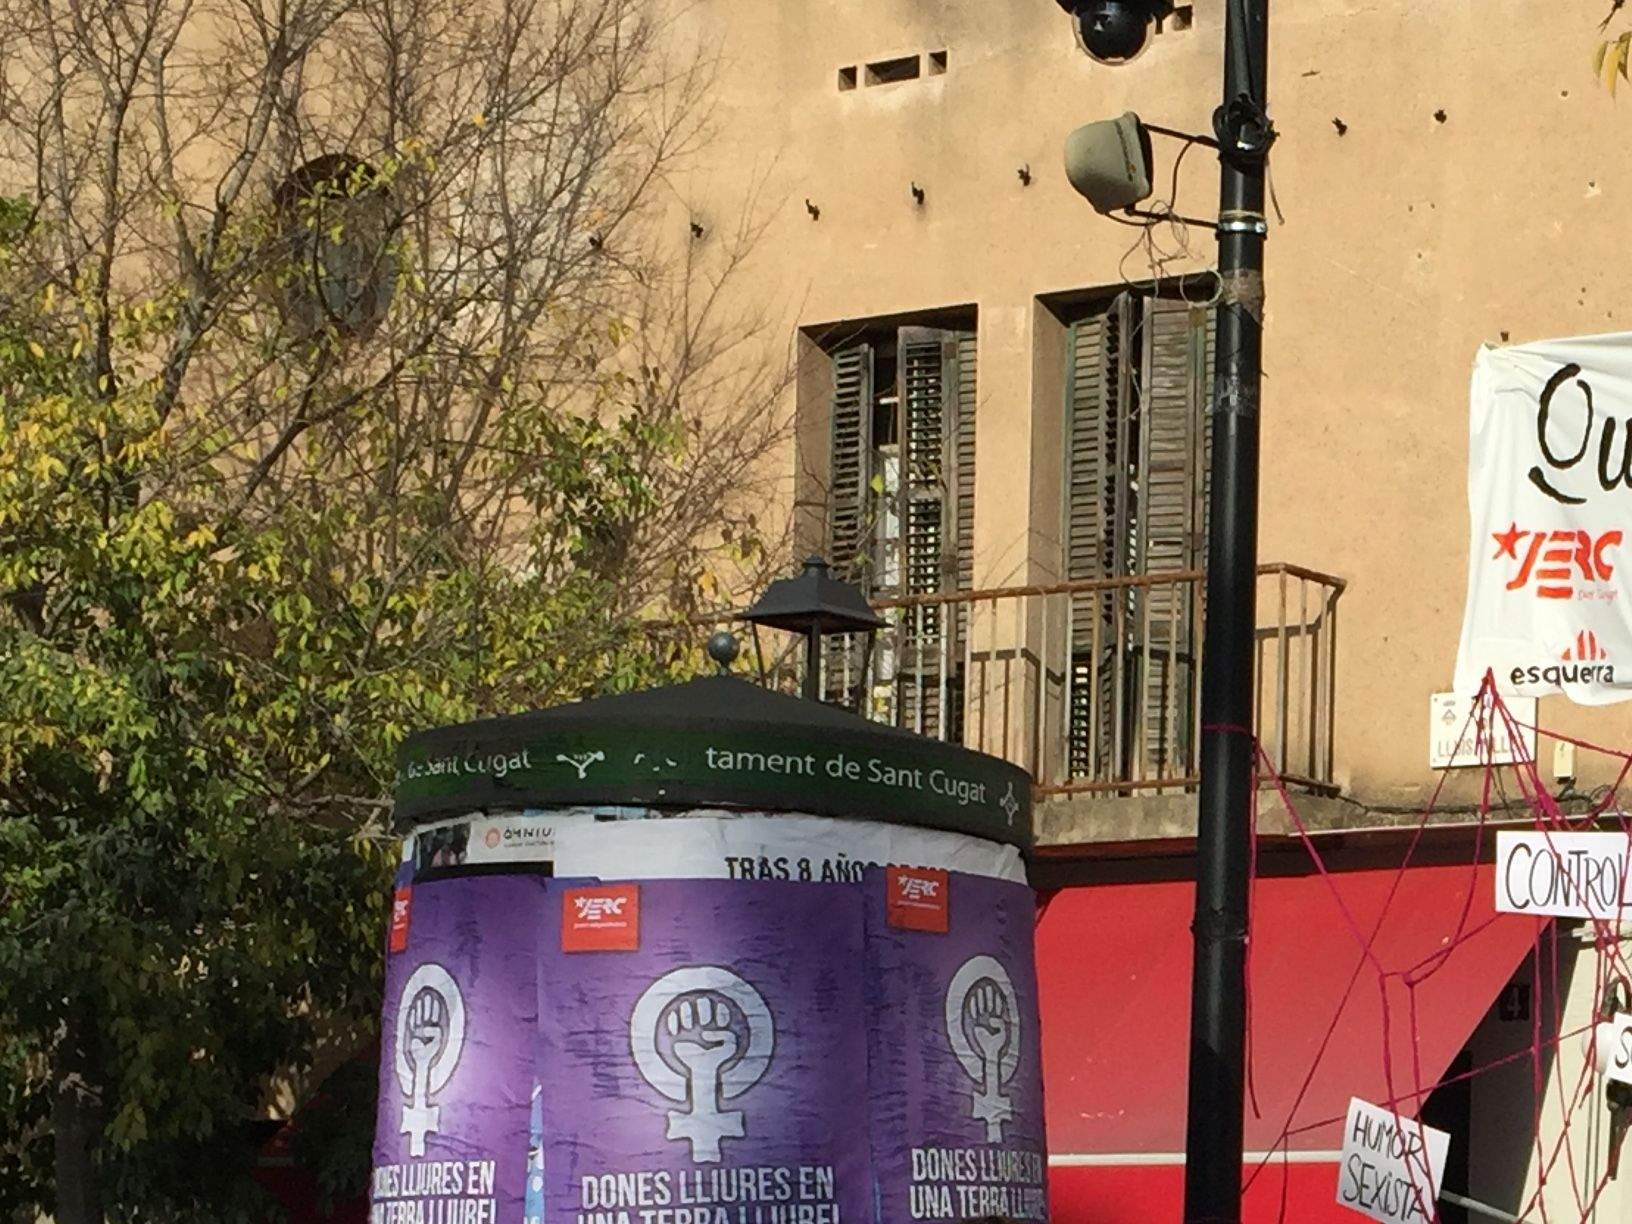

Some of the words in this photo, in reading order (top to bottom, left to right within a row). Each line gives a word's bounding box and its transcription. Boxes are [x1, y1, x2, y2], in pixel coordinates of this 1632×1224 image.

[1510, 664, 1615, 688] esquerra
[705, 746, 815, 776] tament
[826, 753, 861, 780] de
[868, 758, 923, 790] Sant
[929, 770, 987, 805] Cugat
[724, 856, 791, 882] TRAS
[799, 856, 812, 882] 8
[821, 851, 879, 883] AÑO
[1352, 1110, 1432, 1178] HUMOR
[466, 1160, 496, 1195] EN
[911, 1148, 978, 1182] DONES
[581, 1171, 672, 1210] DONES
[678, 1167, 792, 1205] LLIURES
[799, 1166, 834, 1200] EN
[909, 1184, 954, 1220] UNA
[956, 1184, 1010, 1219] TERRA
